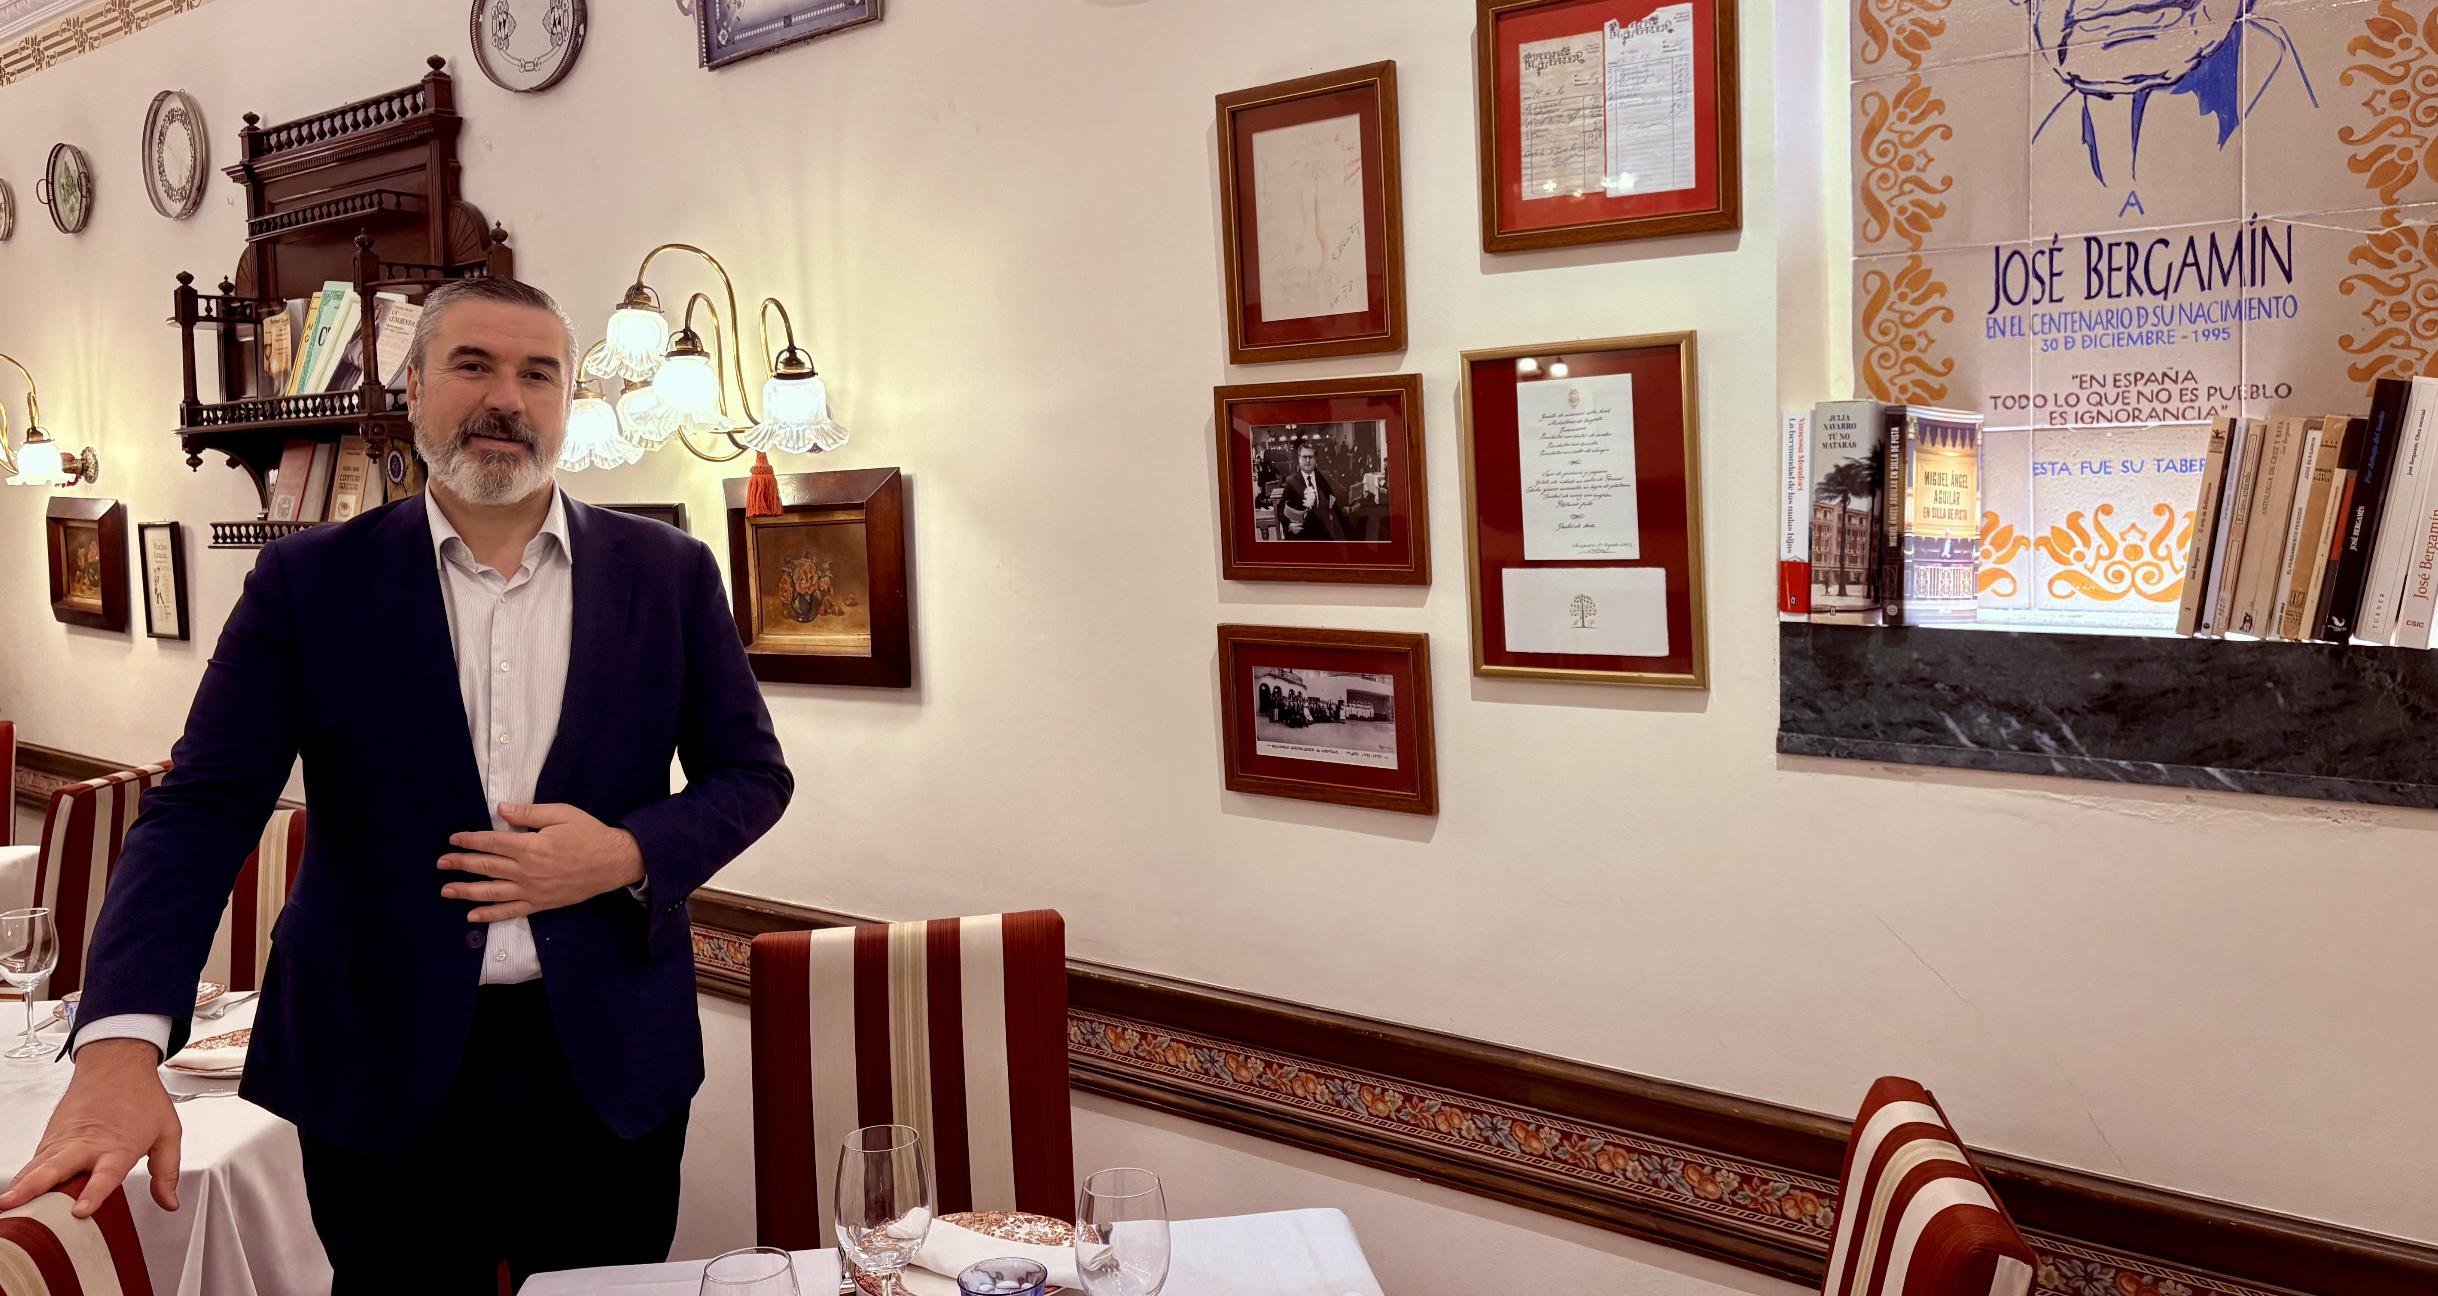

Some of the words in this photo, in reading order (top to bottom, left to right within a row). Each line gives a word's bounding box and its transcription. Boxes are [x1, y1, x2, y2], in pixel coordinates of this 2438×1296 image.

[2118, 190, 2145, 218] A
[1987, 231, 2065, 315] JOSÉ
[2083, 212, 2293, 301] BERGAMÍN
[1986, 315, 2006, 339] EN
[2010, 315, 2026, 337] EL
[2031, 307, 2133, 336] CENTENARIO
[2151, 305, 2175, 328] SU
[2178, 294, 2298, 326] NACIMIENTO
[2041, 338, 2059, 352] 30
[2082, 329, 2176, 350] DICIEMBRE
[2193, 327, 2231, 343] 1995
[2071, 373, 2107, 390] "EN
[2113, 366, 2198, 389] ESPAÑA
[1990, 394, 2048, 411] TODO
[2053, 392, 2081, 408] LO
[2086, 390, 2131, 407] QUE
[2136, 388, 2173, 405] NO
[2179, 387, 2199, 403] ES
[2207, 382, 2293, 402] PUEBLO
[1789, 417, 1796, 429] La
[1829, 414, 1851, 422] JULIA
[2049, 411, 2068, 426] ES
[2074, 404, 2228, 425] IGNORANCIA"
[1823, 422, 1857, 431] NAVARRO
[1891, 426, 1900, 444] PISTA
[1822, 440, 1857, 450] MATARÁS
[1828, 432, 1838, 441] TÚ
[1839, 433, 1851, 441] NO
[1891, 444, 1900, 452] DE
[1890, 453, 1900, 470] SILLA
[2032, 461, 2072, 476] ESTA
[2080, 460, 2112, 475] FUE
[2120, 459, 2145, 474] SU
[1890, 470, 1899, 479] EN
[1924, 470, 1949, 487] MIGUEL
[1950, 469, 1969, 489] ÁNGEL
[1788, 480, 1795, 490] de
[1933, 488, 1961, 506] AGUILAR
[1923, 506, 1930, 519] EN
[1931, 507, 1946, 520] SILLA
[1947, 507, 1954, 520] DE
[1954, 508, 1968, 521] PISTA
[2418, 508, 2438, 570] Bergamín
[2413, 573, 2430, 601] José
[2406, 619, 2425, 629] CSIC
